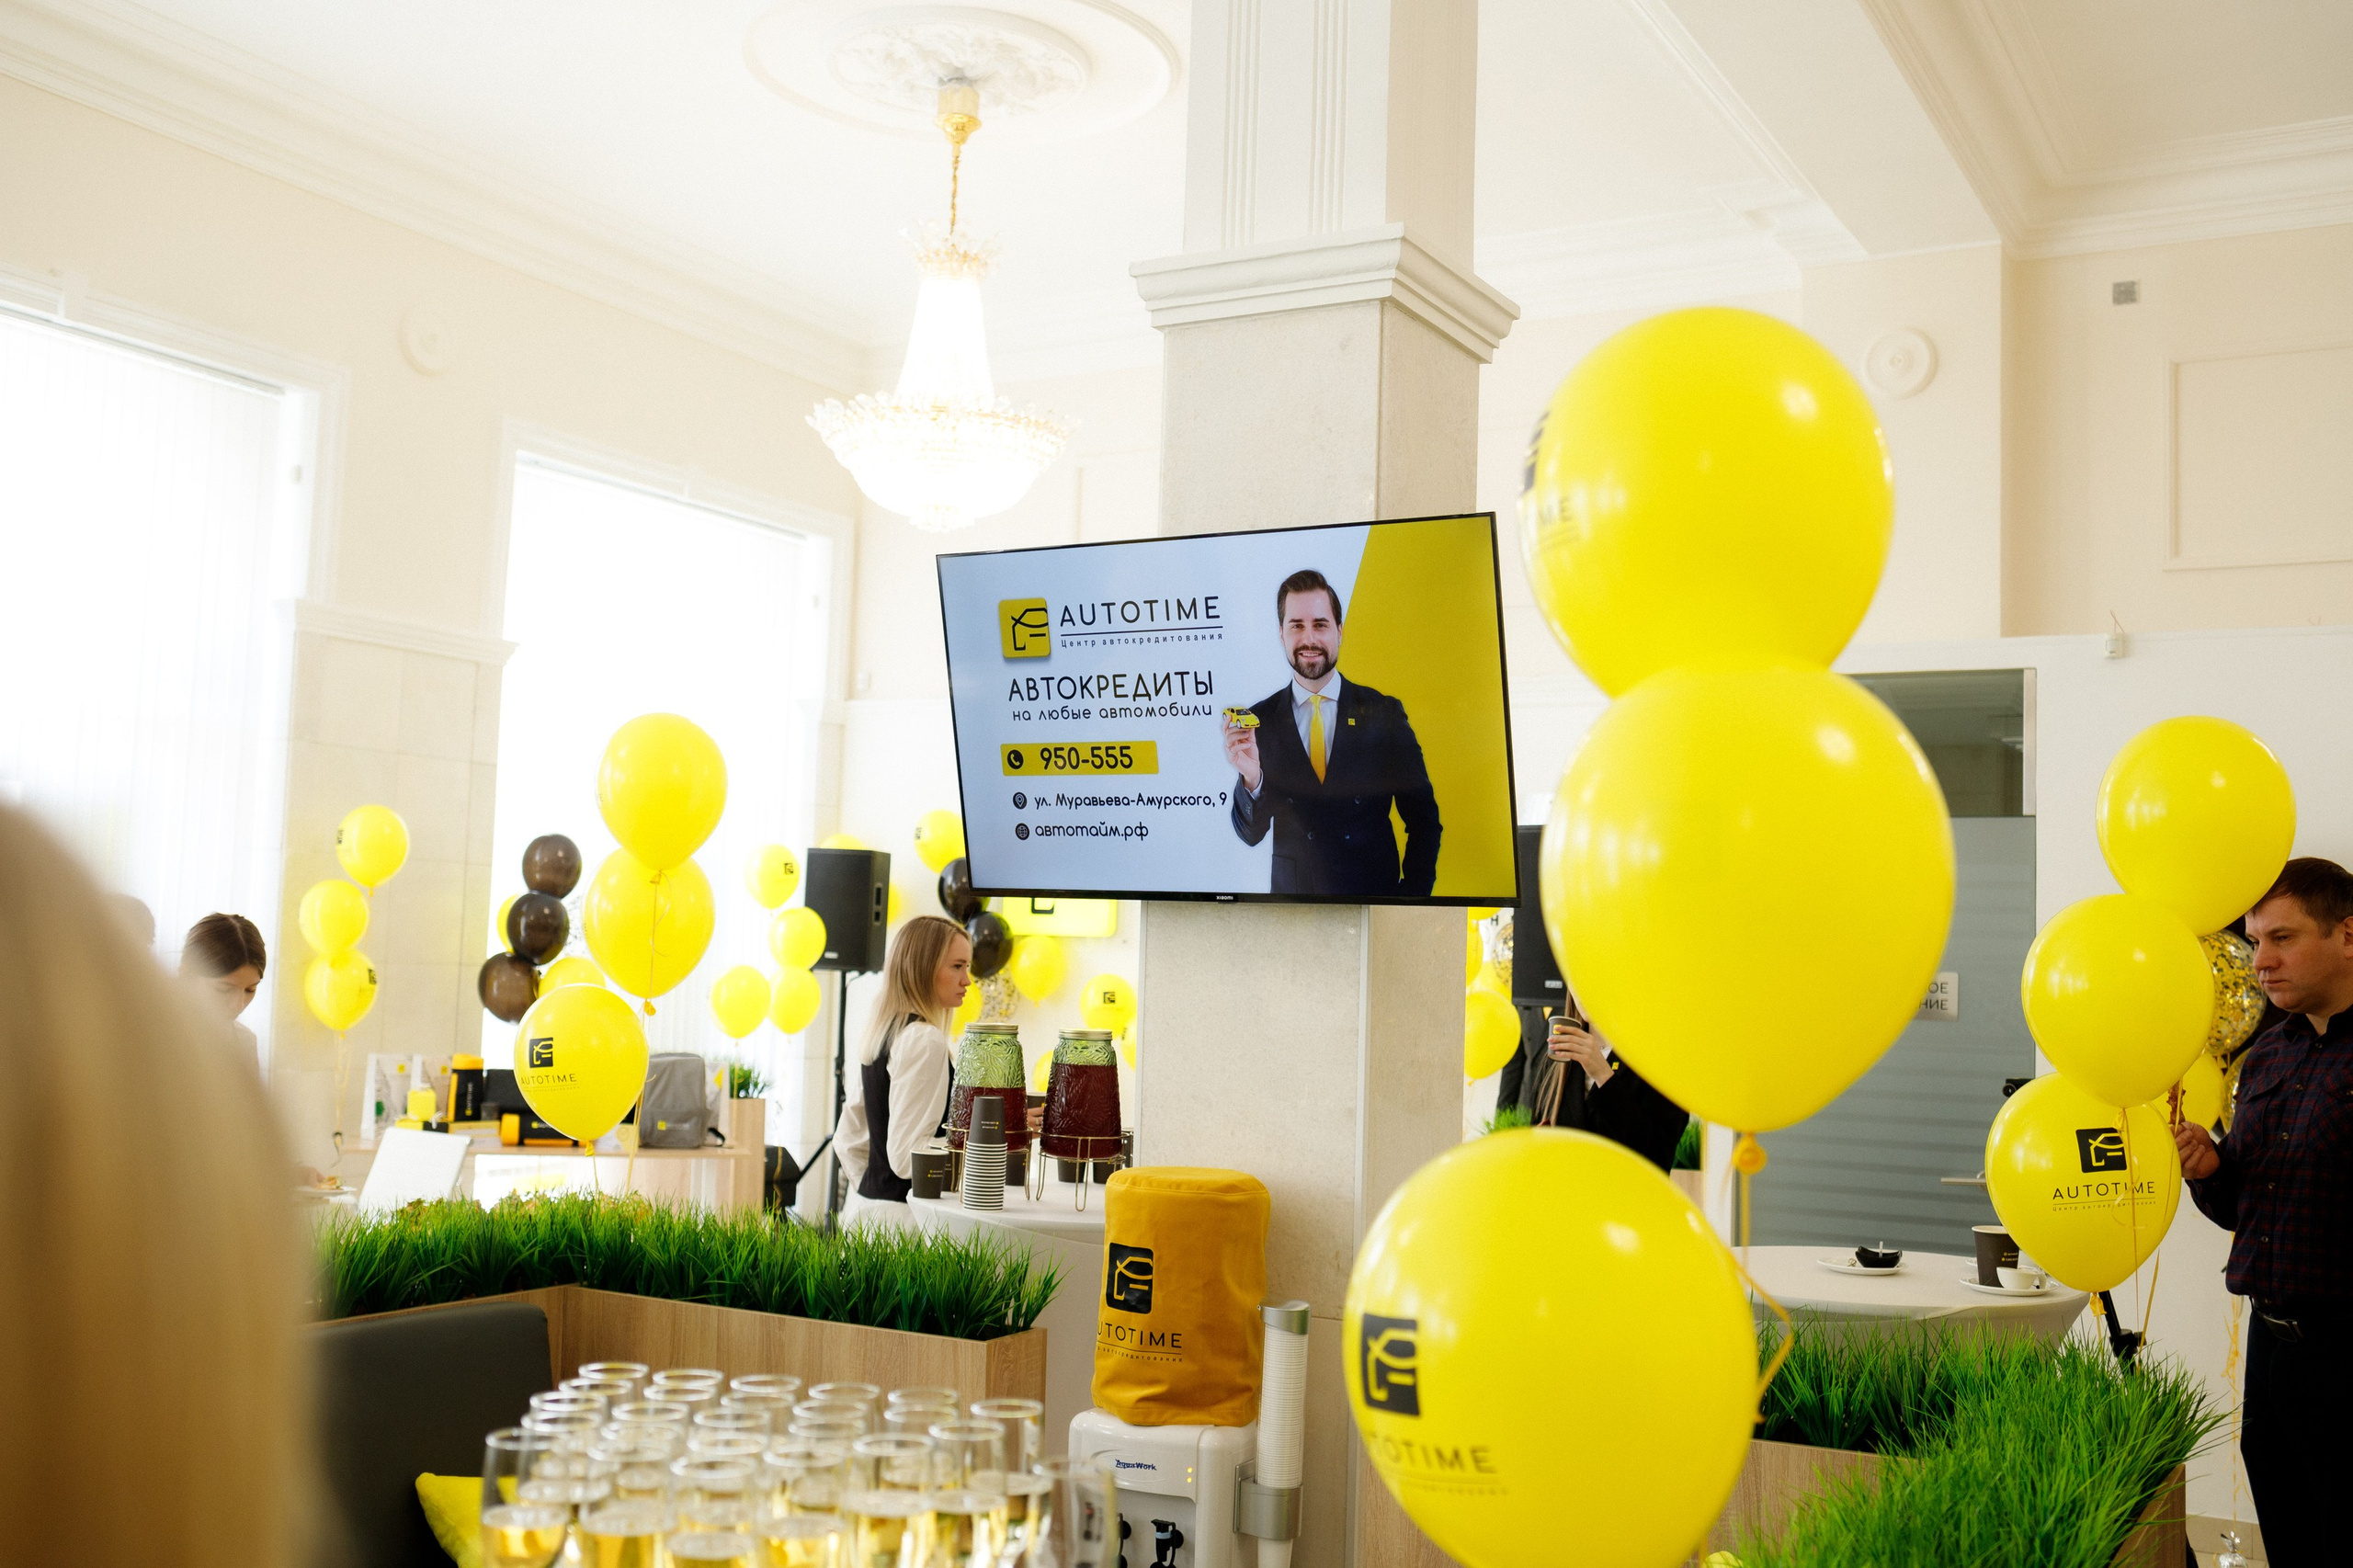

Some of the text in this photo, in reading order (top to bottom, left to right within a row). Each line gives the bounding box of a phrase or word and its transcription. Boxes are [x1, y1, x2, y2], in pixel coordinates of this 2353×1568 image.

[1060, 596, 1221, 627] AUTOTIME
[1061, 632, 1223, 649] Центр автокредитования
[1008, 670, 1214, 702] АВТОКРЕДИТЫ
[1012, 701, 1212, 722] на любые автомобили
[1040, 745, 1133, 770] 950-555
[1034, 791, 1228, 810] ул. Муравьева-Амурского, 9
[1035, 821, 1149, 841] автотайм.рф
[1927, 982, 1949, 994] ОЕ
[1918, 998, 1949, 1011] НИЕ
[520, 1074, 577, 1085] AUTOTIME
[2052, 1181, 2155, 1200] AUTOTIME
[1097, 1321, 1183, 1349] UTOTIME
